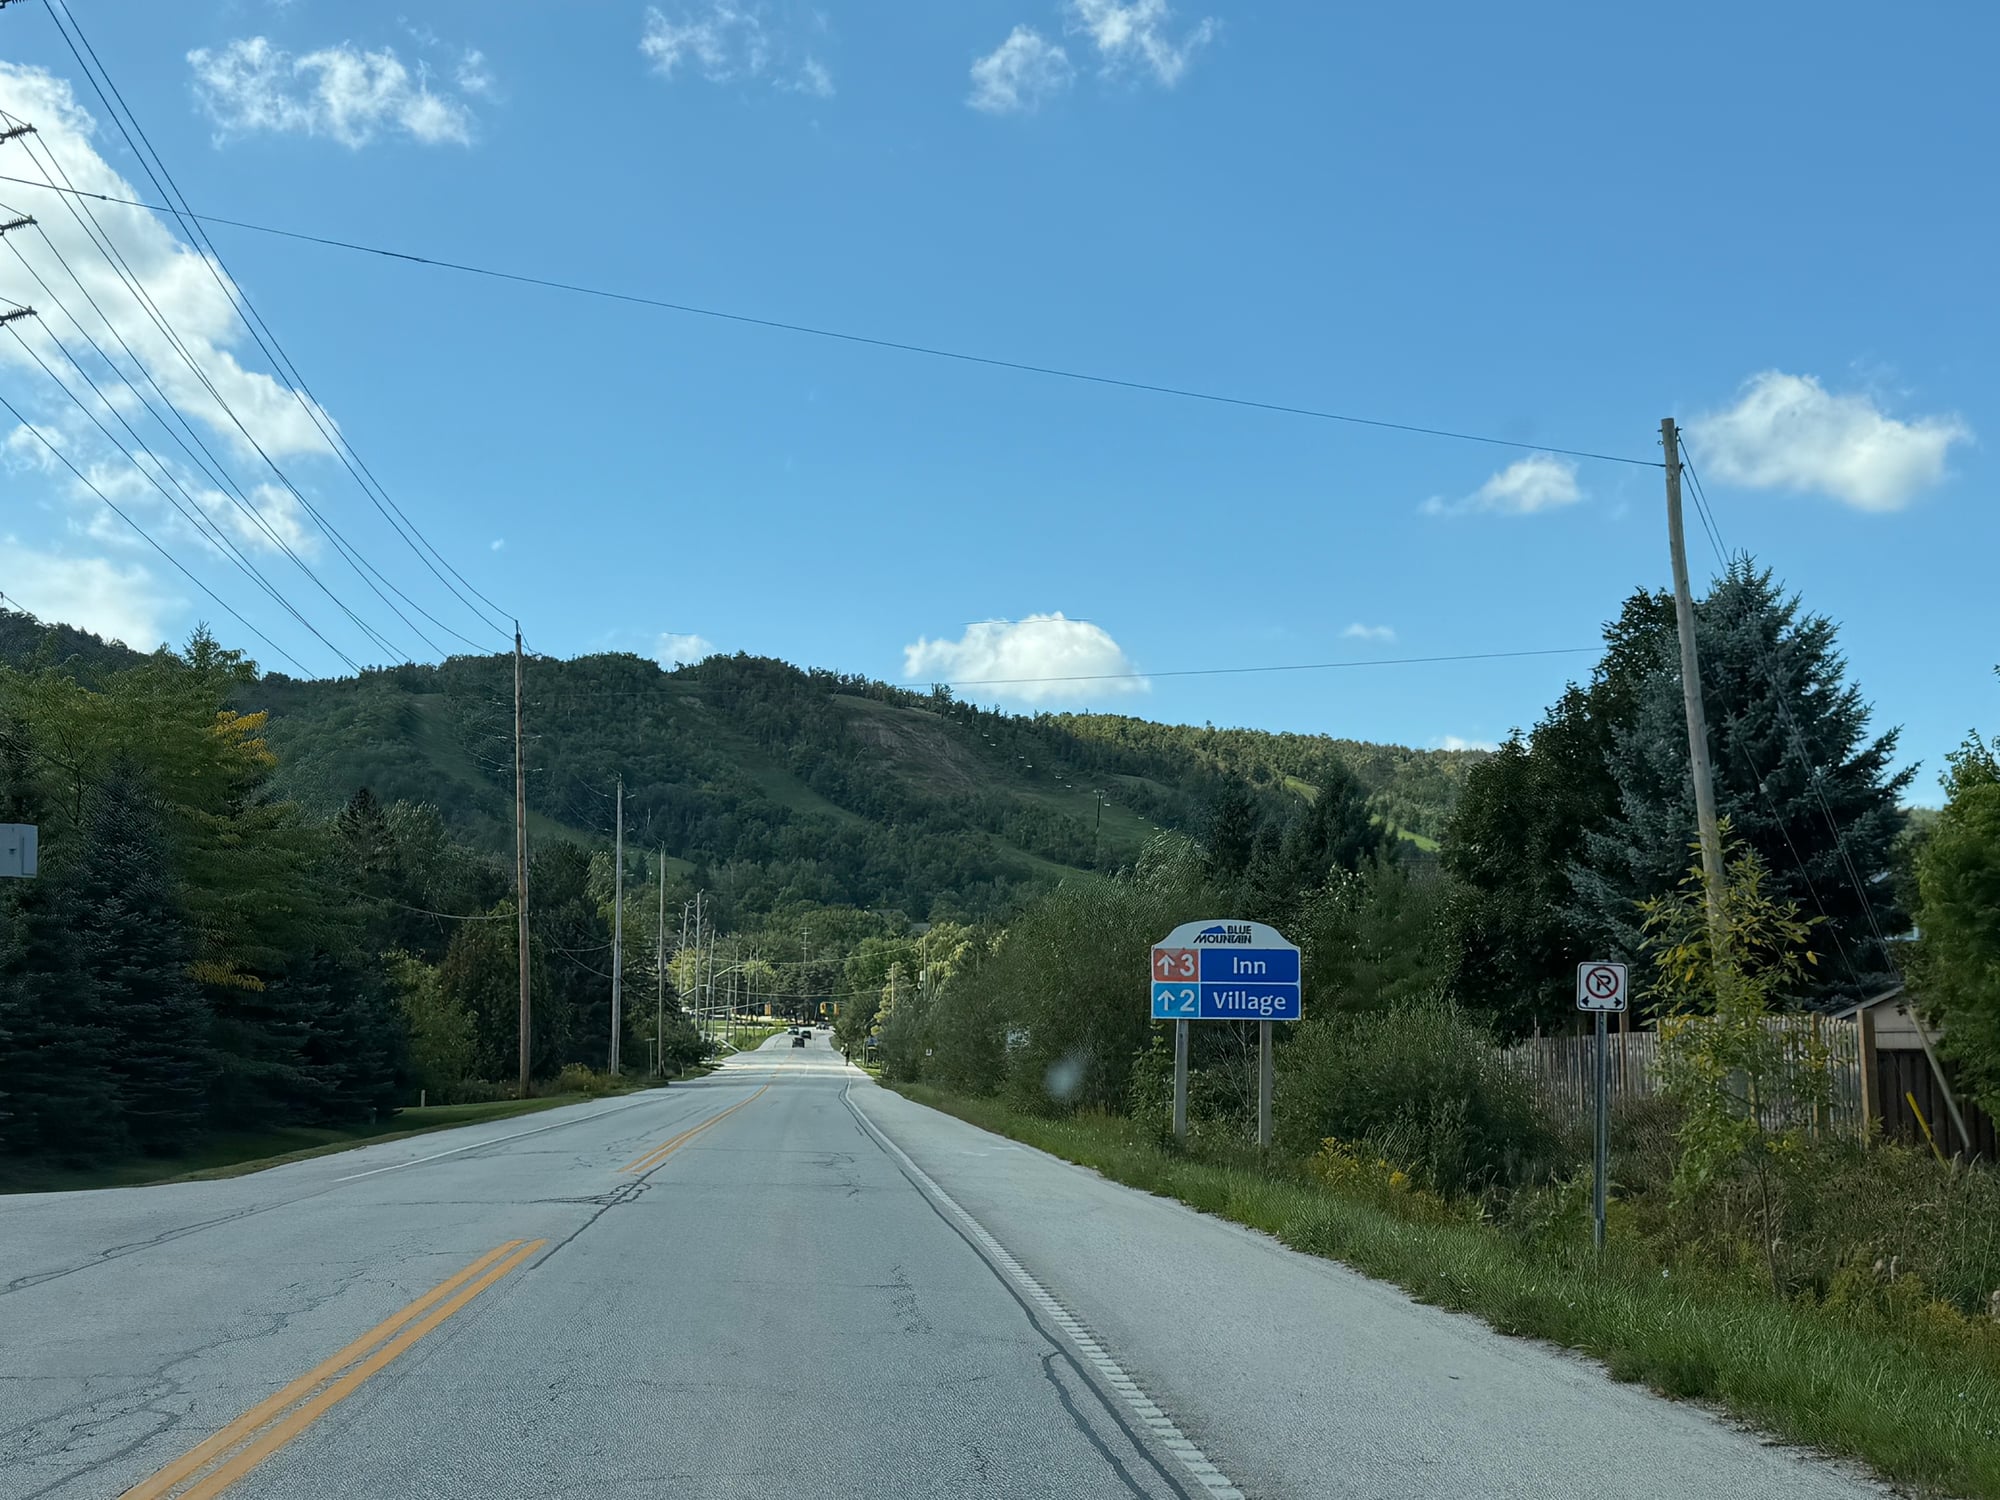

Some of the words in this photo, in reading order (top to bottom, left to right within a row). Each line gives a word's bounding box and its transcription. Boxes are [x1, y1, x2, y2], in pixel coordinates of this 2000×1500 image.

[1227, 925, 1252, 934] BLUE
[1193, 934, 1252, 944] MOUNTAIN
[1180, 953, 1195, 976] 3
[1233, 956, 1266, 974] Inn
[1179, 989, 1195, 1012] 2
[1213, 991, 1287, 1016] Village
